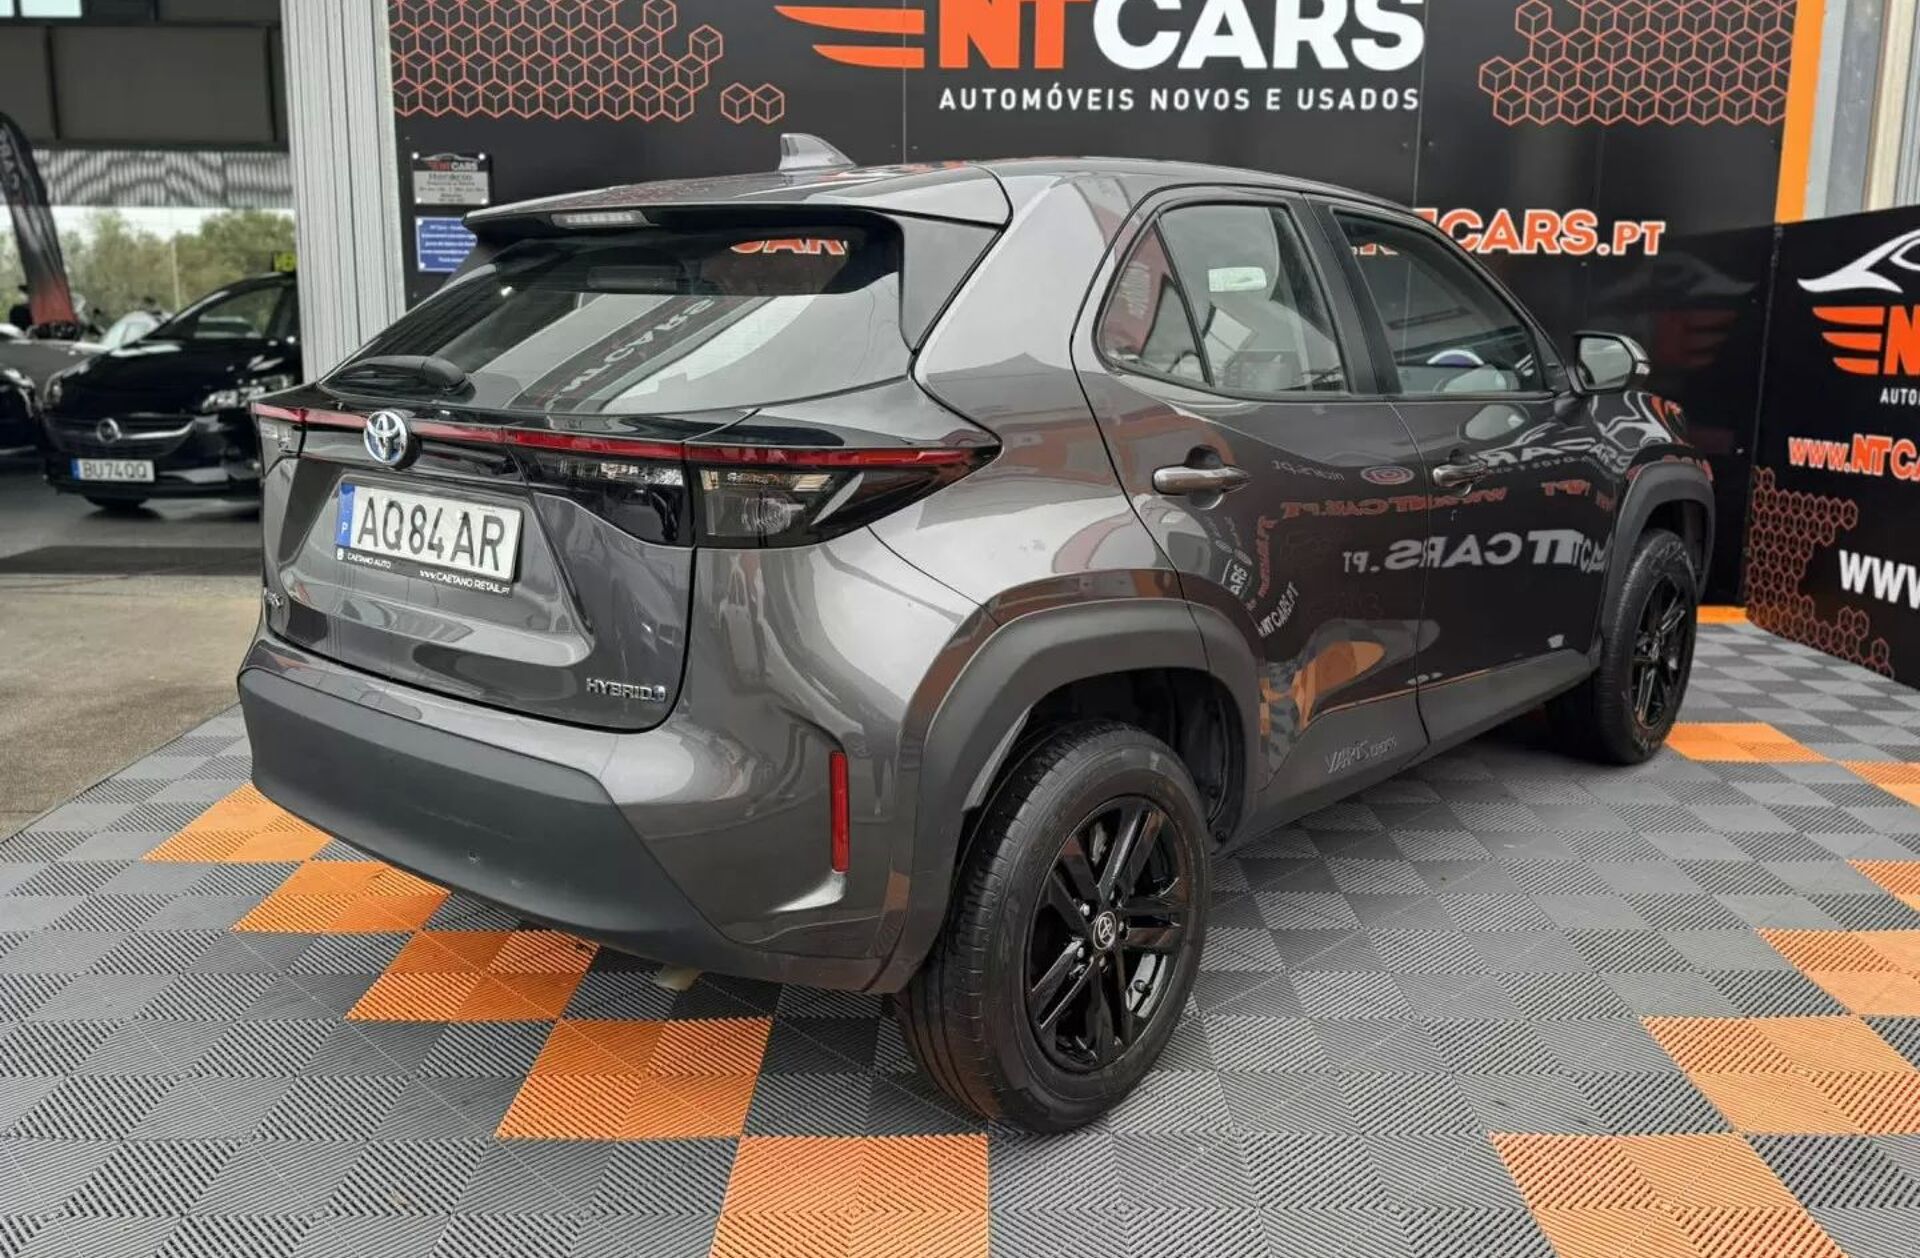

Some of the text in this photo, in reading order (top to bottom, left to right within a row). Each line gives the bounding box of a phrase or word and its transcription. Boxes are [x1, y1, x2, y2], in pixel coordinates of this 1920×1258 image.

[939, 83, 1419, 110] AUTOMÓVEIS NOVOS E USADOS
[1879, 387, 1920, 406] AUTO
[586, 677, 653, 701] HYBRID
